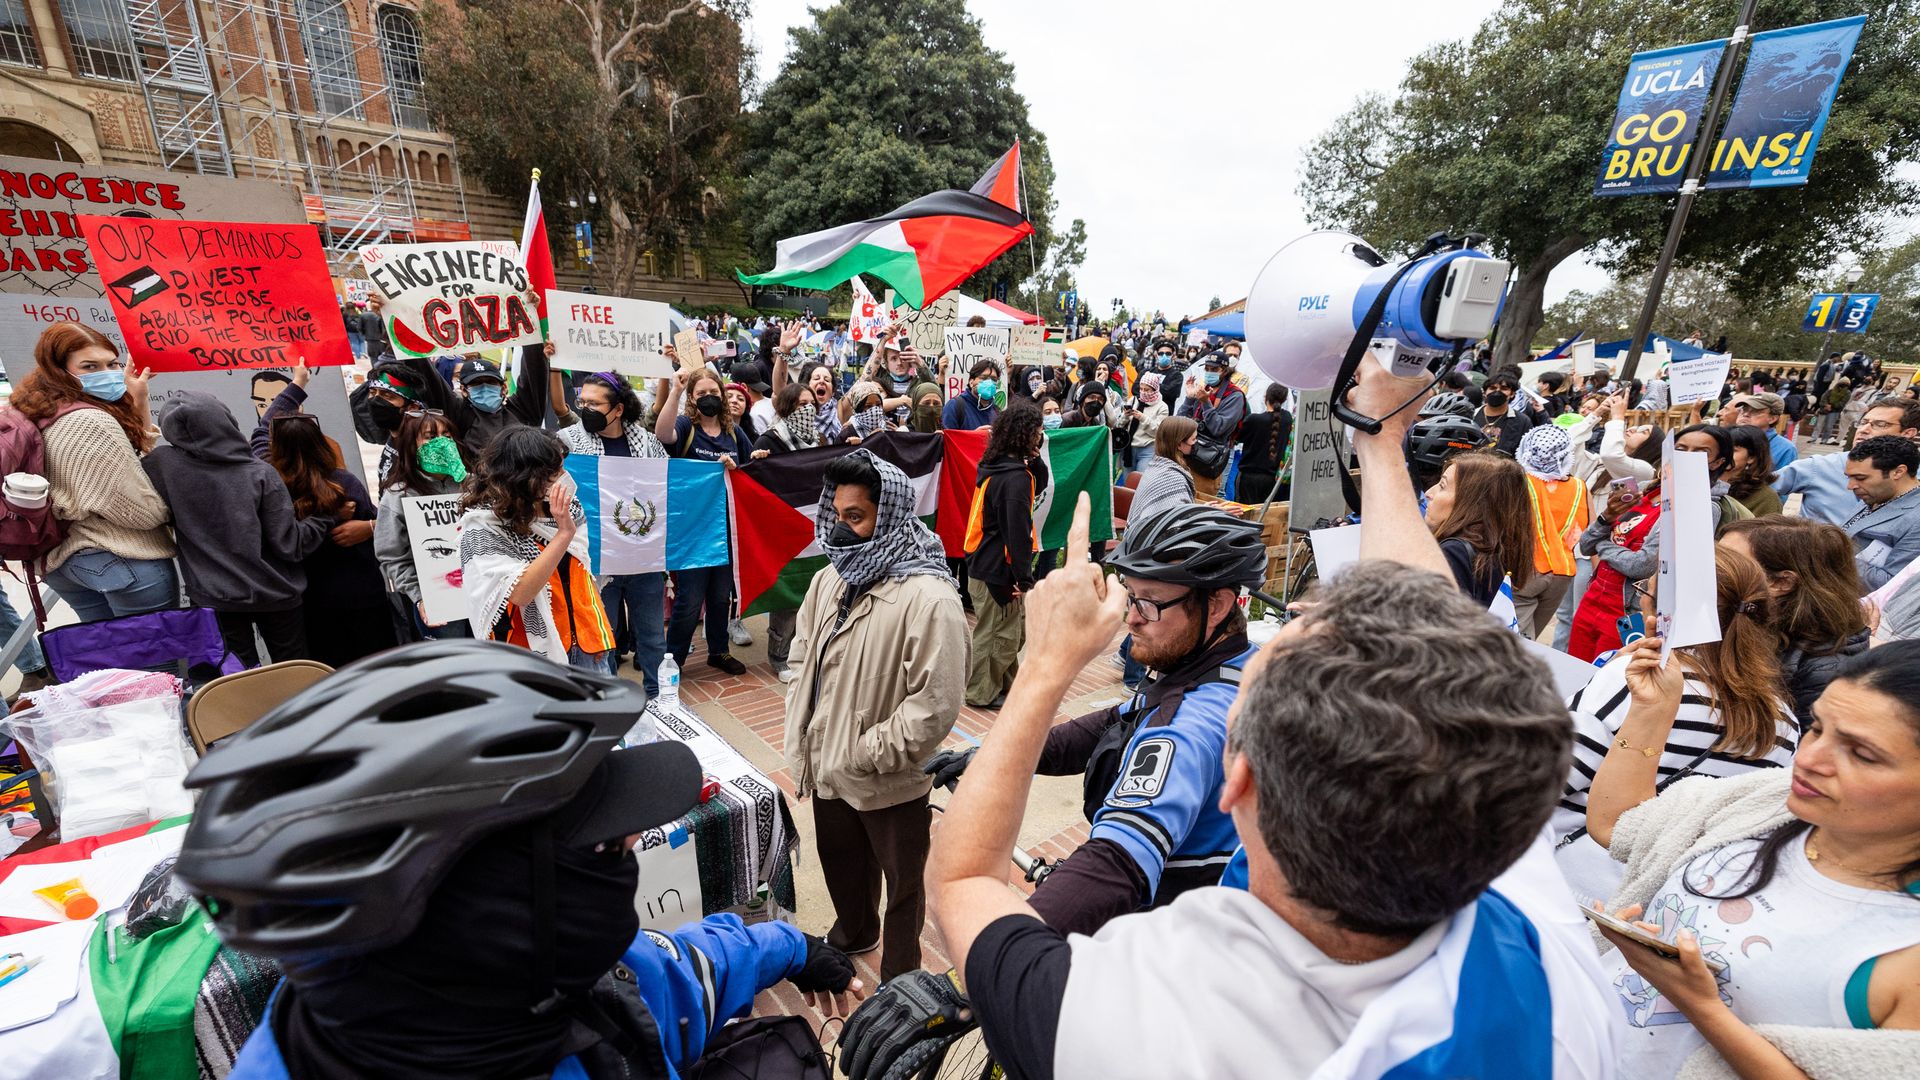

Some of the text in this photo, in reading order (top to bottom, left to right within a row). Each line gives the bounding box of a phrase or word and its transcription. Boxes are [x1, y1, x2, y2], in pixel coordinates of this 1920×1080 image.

[1630, 65, 1705, 97] UCLA
[1615, 109, 1687, 146] GO
[1604, 143, 1692, 181] BRU
[1709, 130, 1813, 172] INS!
[1771, 167, 1799, 176] @ucla
[1602, 180, 1631, 189] ucla.edu
[98, 223, 303, 263] OUR DEMANDS
[363, 241, 518, 263] UC DIVEST
[169, 266, 261, 290] DIVEST
[370, 250, 528, 299] ENGINEERS
[176, 289, 273, 308] DISCLOSE
[441, 282, 476, 298] FOR
[23, 303, 81, 323] 4650
[1298, 294, 1331, 311] PYLE
[1844, 296, 1872, 328] UCLA
[139, 306, 312, 330] ABOLISH POLICING
[423, 295, 535, 348] GAZA
[570, 304, 614, 325] FREE
[144, 329, 190, 351] END
[200, 326, 241, 343] THE
[251, 323, 322, 343] SILENCE
[568, 328, 663, 355] PALESTINE!
[946, 332, 964, 352] MY
[999, 342, 1007, 355] IS
[189, 345, 287, 367] BOYCOTT
[952, 353, 983, 374] NOT
[1397, 353, 1424, 366] PYLE
[1310, 459, 1336, 482] HERE
[1121, 776, 1156, 792] CSC
[644, 888, 684, 919] in
